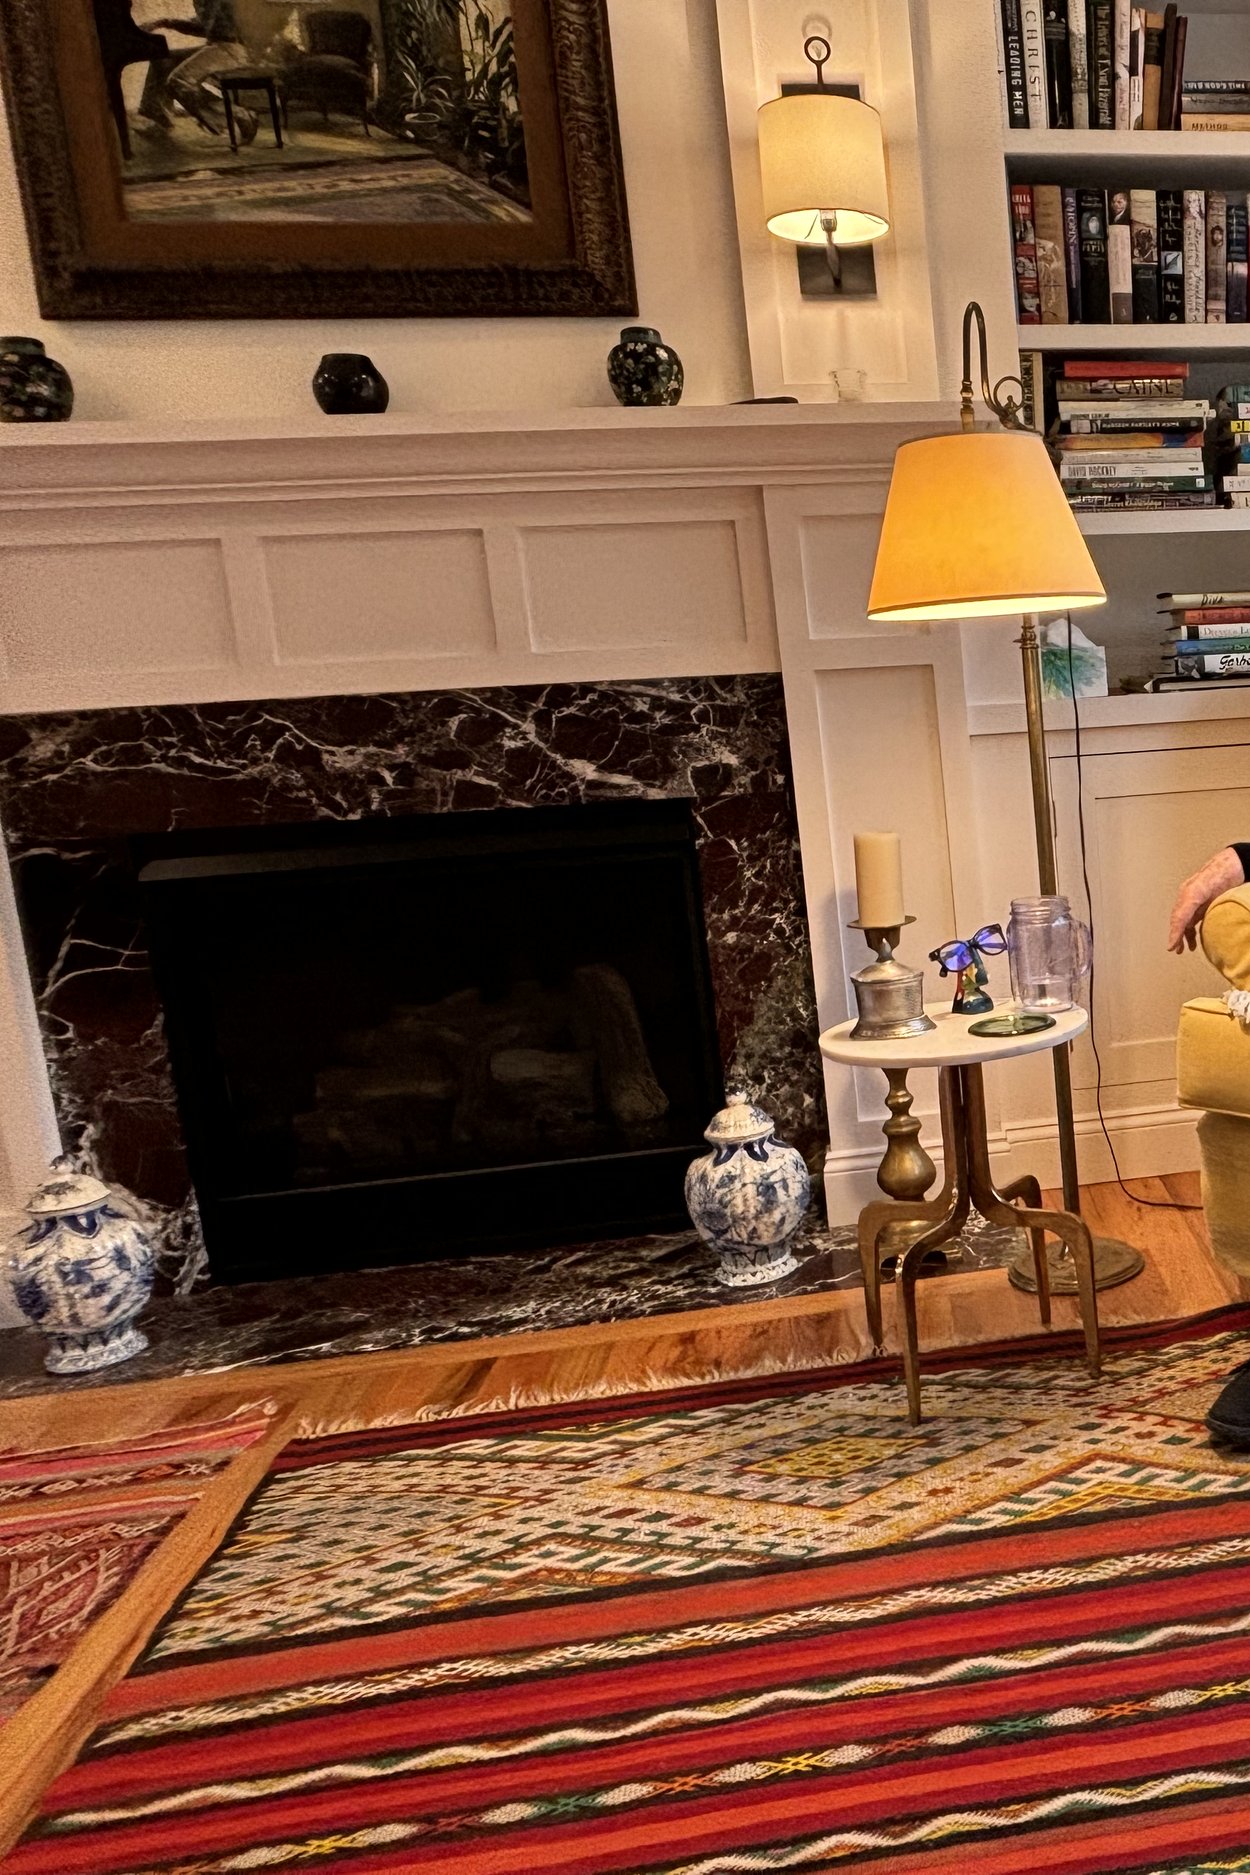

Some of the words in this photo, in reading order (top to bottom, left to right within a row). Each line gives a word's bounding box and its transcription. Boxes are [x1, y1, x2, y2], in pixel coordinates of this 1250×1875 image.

[1008, 36, 1022, 86] LEADING
[1012, 91, 1024, 115] MEN
[1201, 594, 1223, 606] Diva
